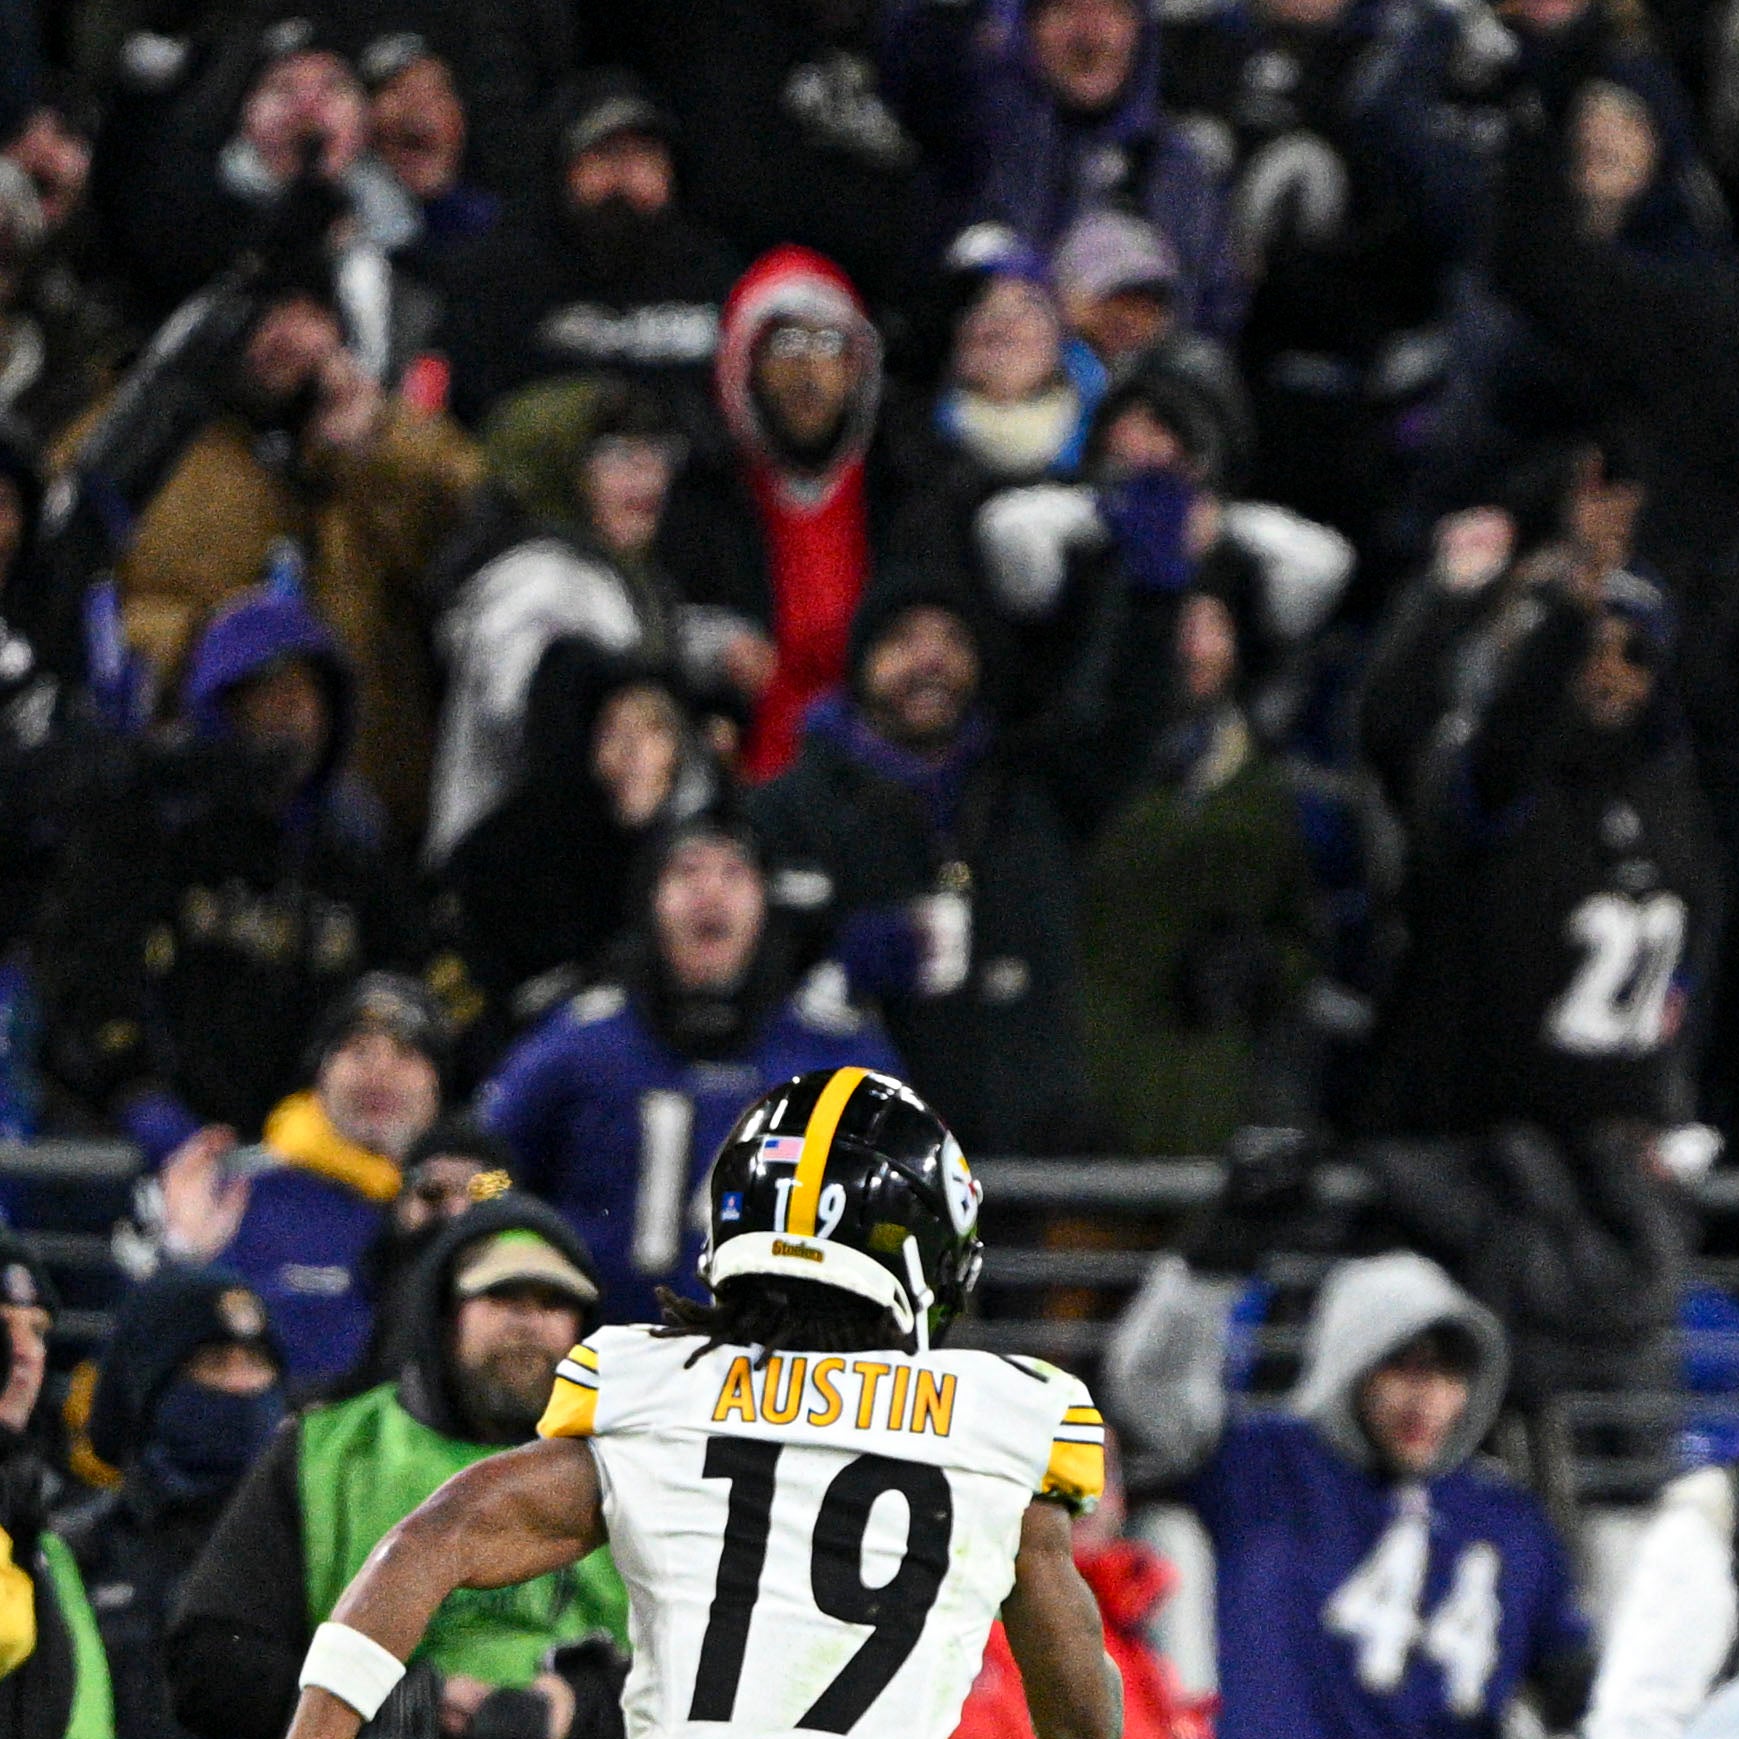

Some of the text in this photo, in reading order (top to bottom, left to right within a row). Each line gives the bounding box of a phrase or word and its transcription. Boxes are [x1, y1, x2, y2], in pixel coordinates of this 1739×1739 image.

[774, 1177, 847, 1240] 19
[711, 1355, 958, 1437] AUSTIN
[687, 1435, 954, 1736] 19
[1322, 1516, 1503, 1718] 44
